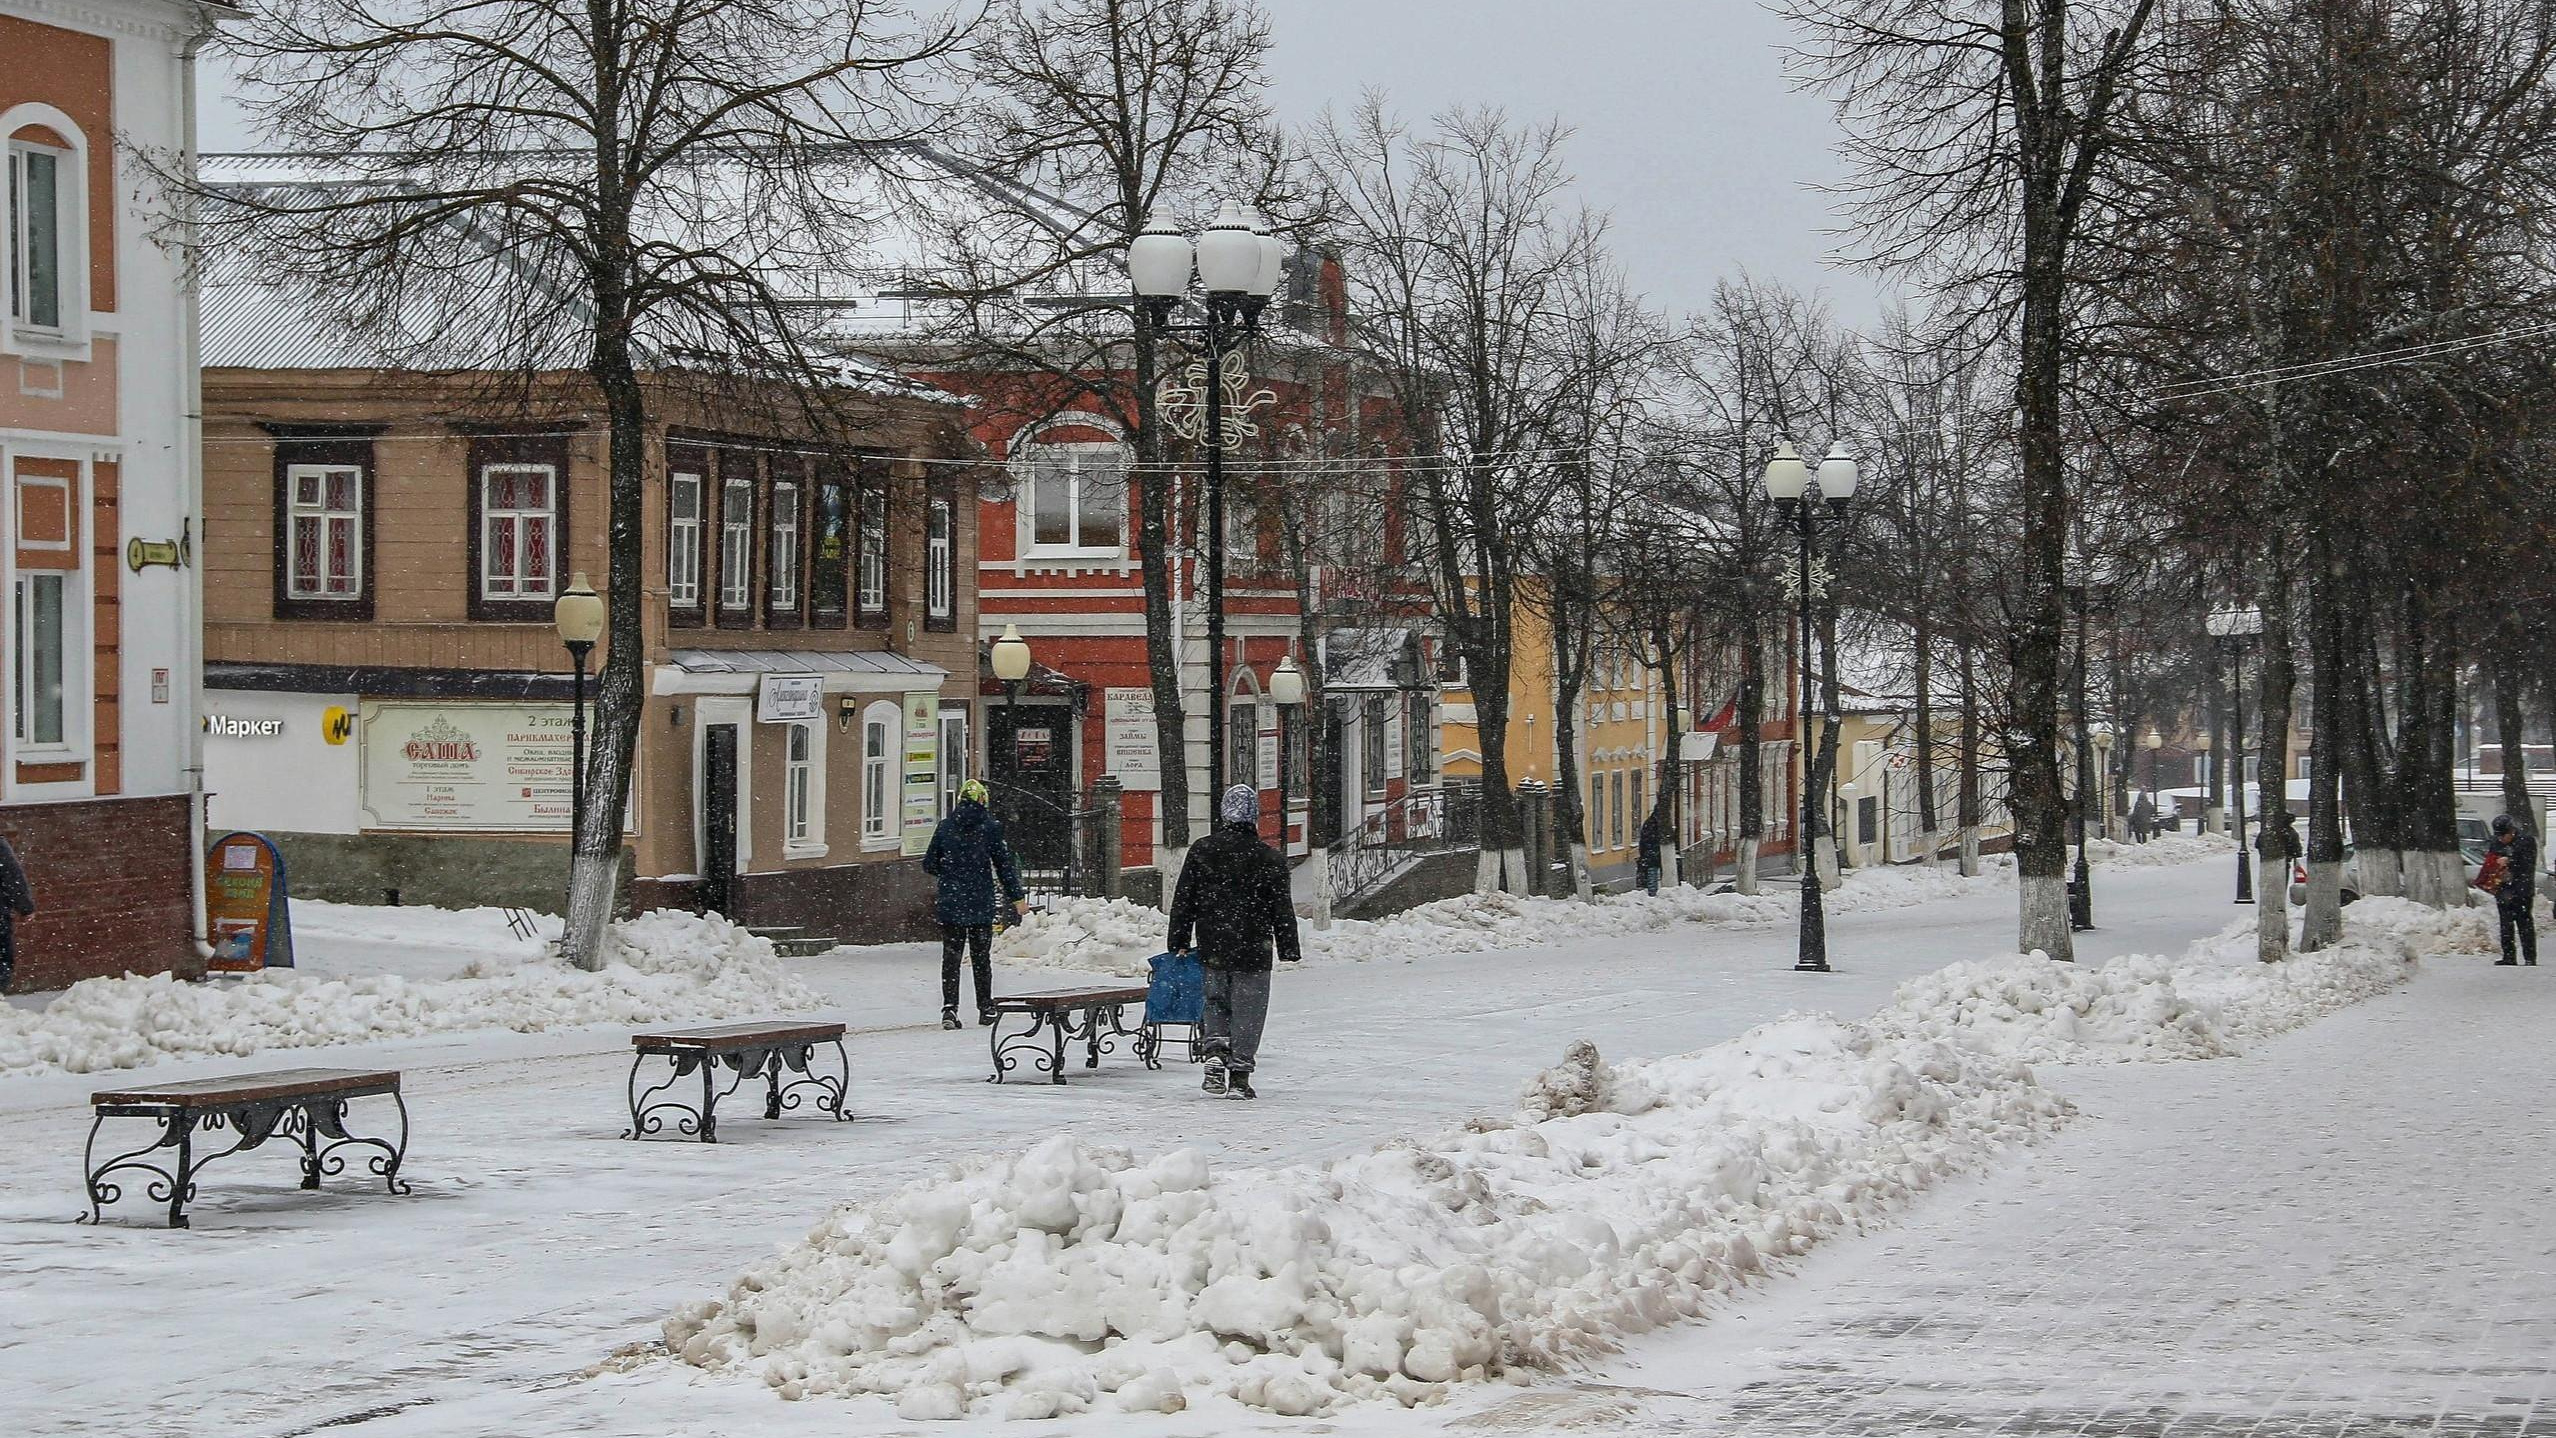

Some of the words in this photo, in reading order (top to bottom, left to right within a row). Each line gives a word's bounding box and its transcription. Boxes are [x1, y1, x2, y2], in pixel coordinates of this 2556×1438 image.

[210, 715, 282, 738] Маркет
[528, 715, 537, 727] 2
[405, 742, 476, 760] САША
